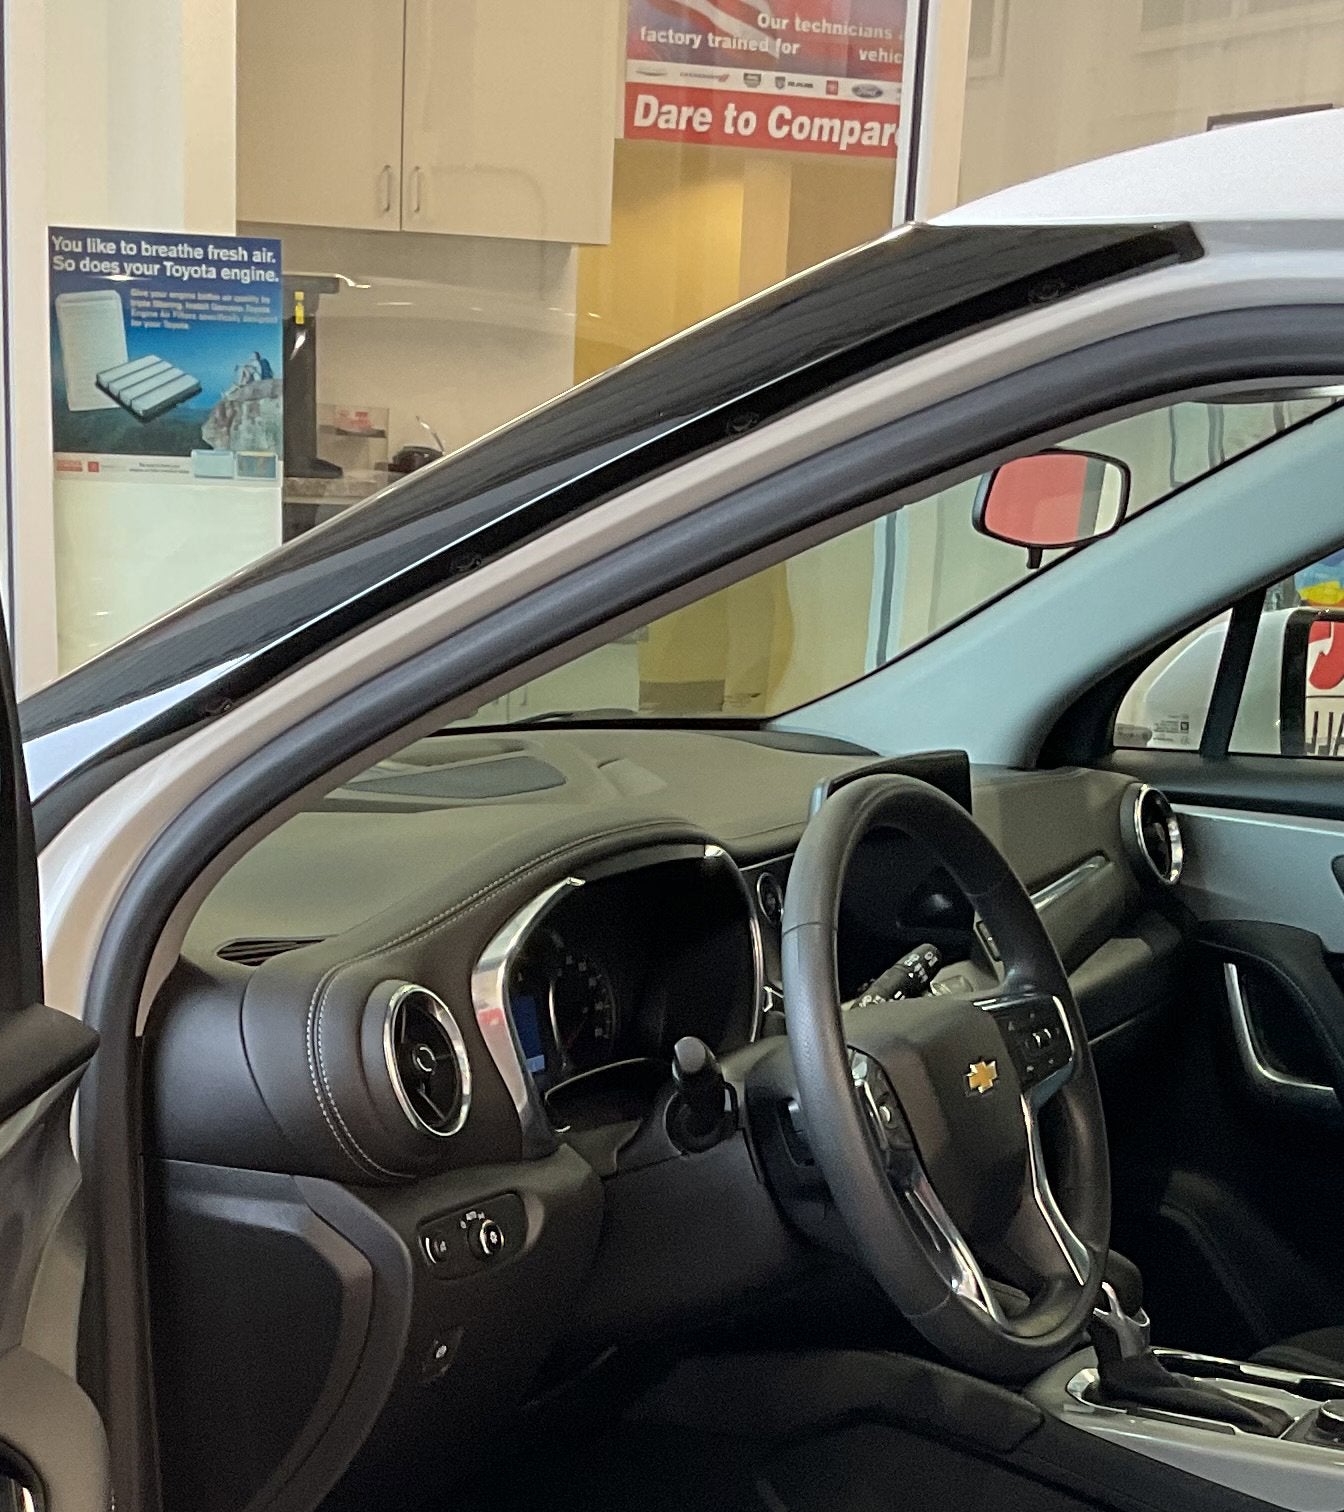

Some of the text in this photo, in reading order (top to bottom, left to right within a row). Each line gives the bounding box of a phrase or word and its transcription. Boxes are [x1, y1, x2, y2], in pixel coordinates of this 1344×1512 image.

[640, 26, 702, 49] factory
[707, 32, 769, 52] trained
[775, 37, 801, 54] for
[757, 12, 892, 41] Our technicians
[633, 94, 713, 133] Dare
[723, 103, 757, 136] to
[52, 235, 276, 263] You like to breathe fresh air.
[52, 255, 279, 284] So does your Toyota engine.
